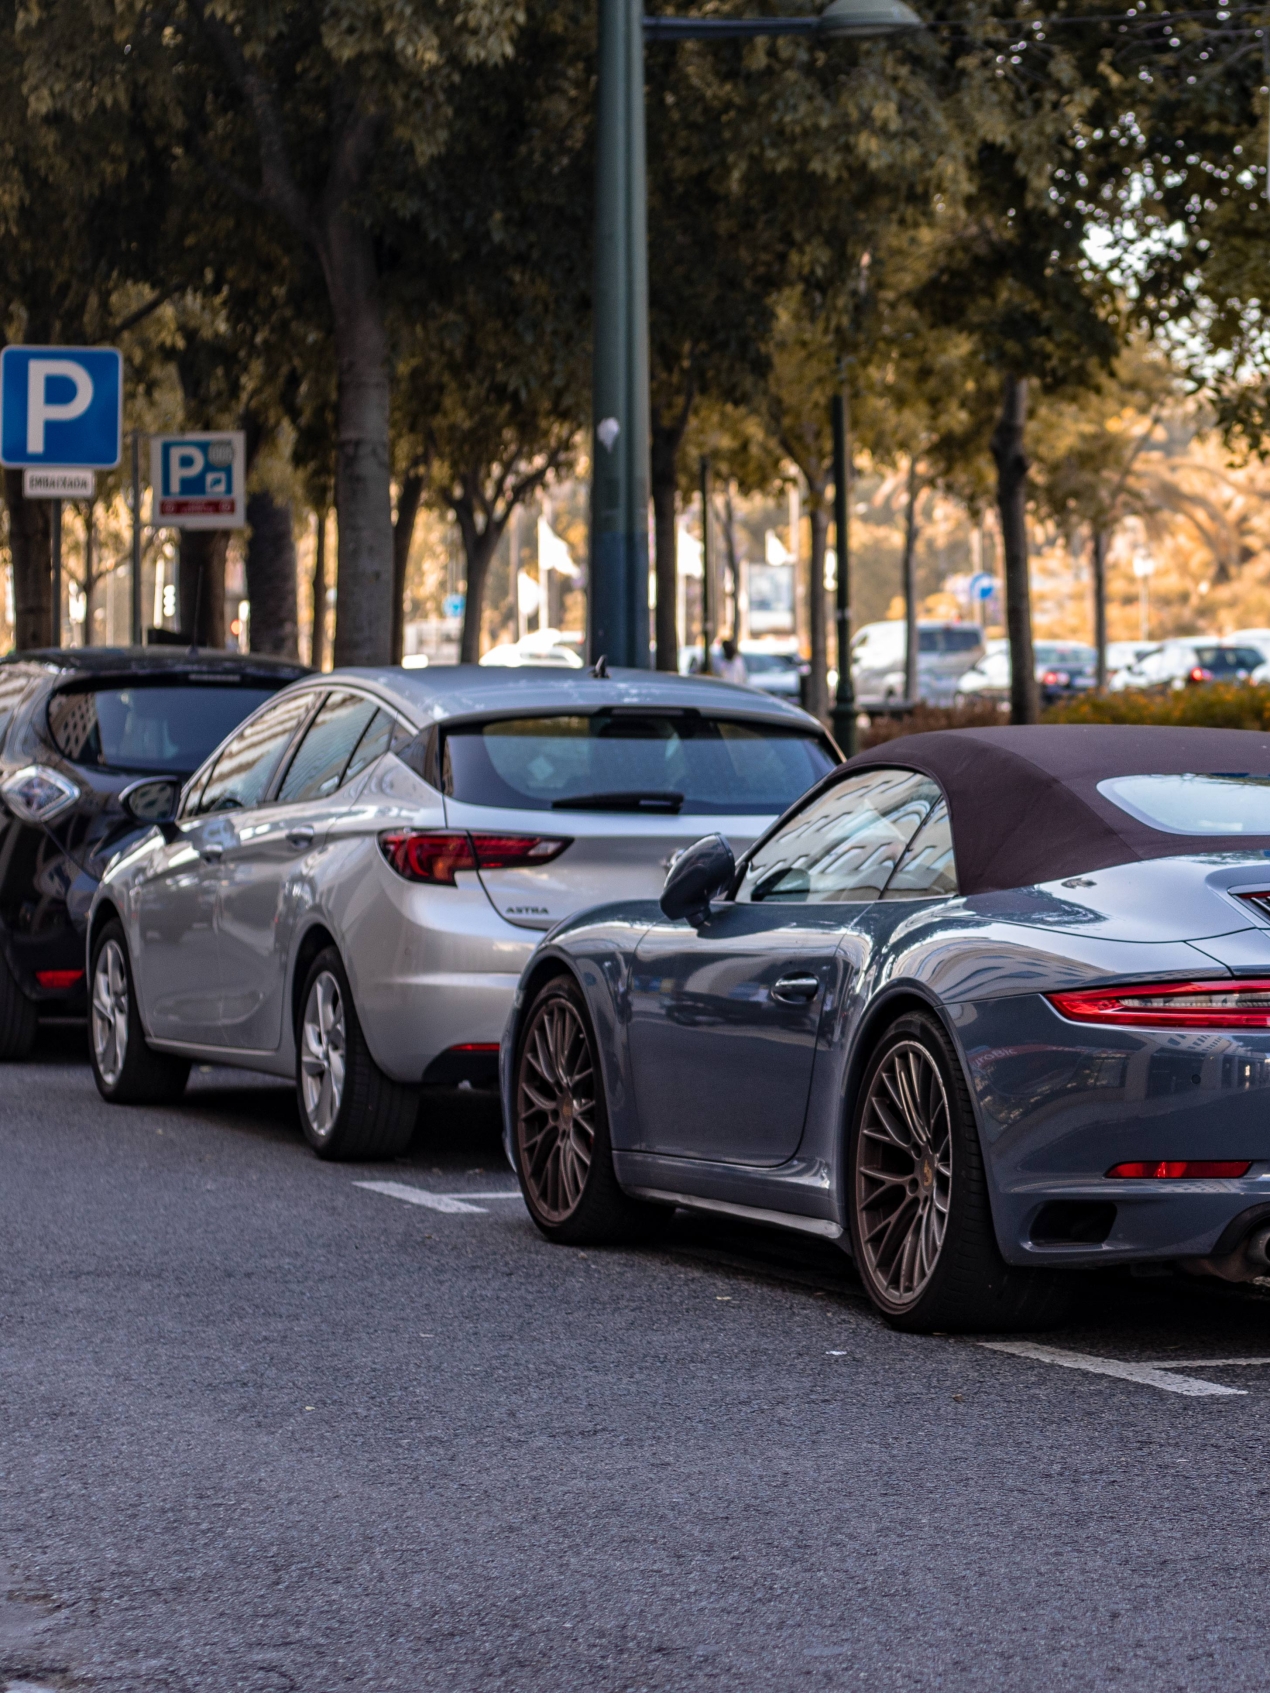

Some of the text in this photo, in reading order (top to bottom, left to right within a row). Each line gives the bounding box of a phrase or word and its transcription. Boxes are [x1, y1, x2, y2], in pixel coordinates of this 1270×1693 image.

[27, 359, 94, 454] P
[169, 445, 205, 493] P
[506, 906, 549, 915] ASTRA
